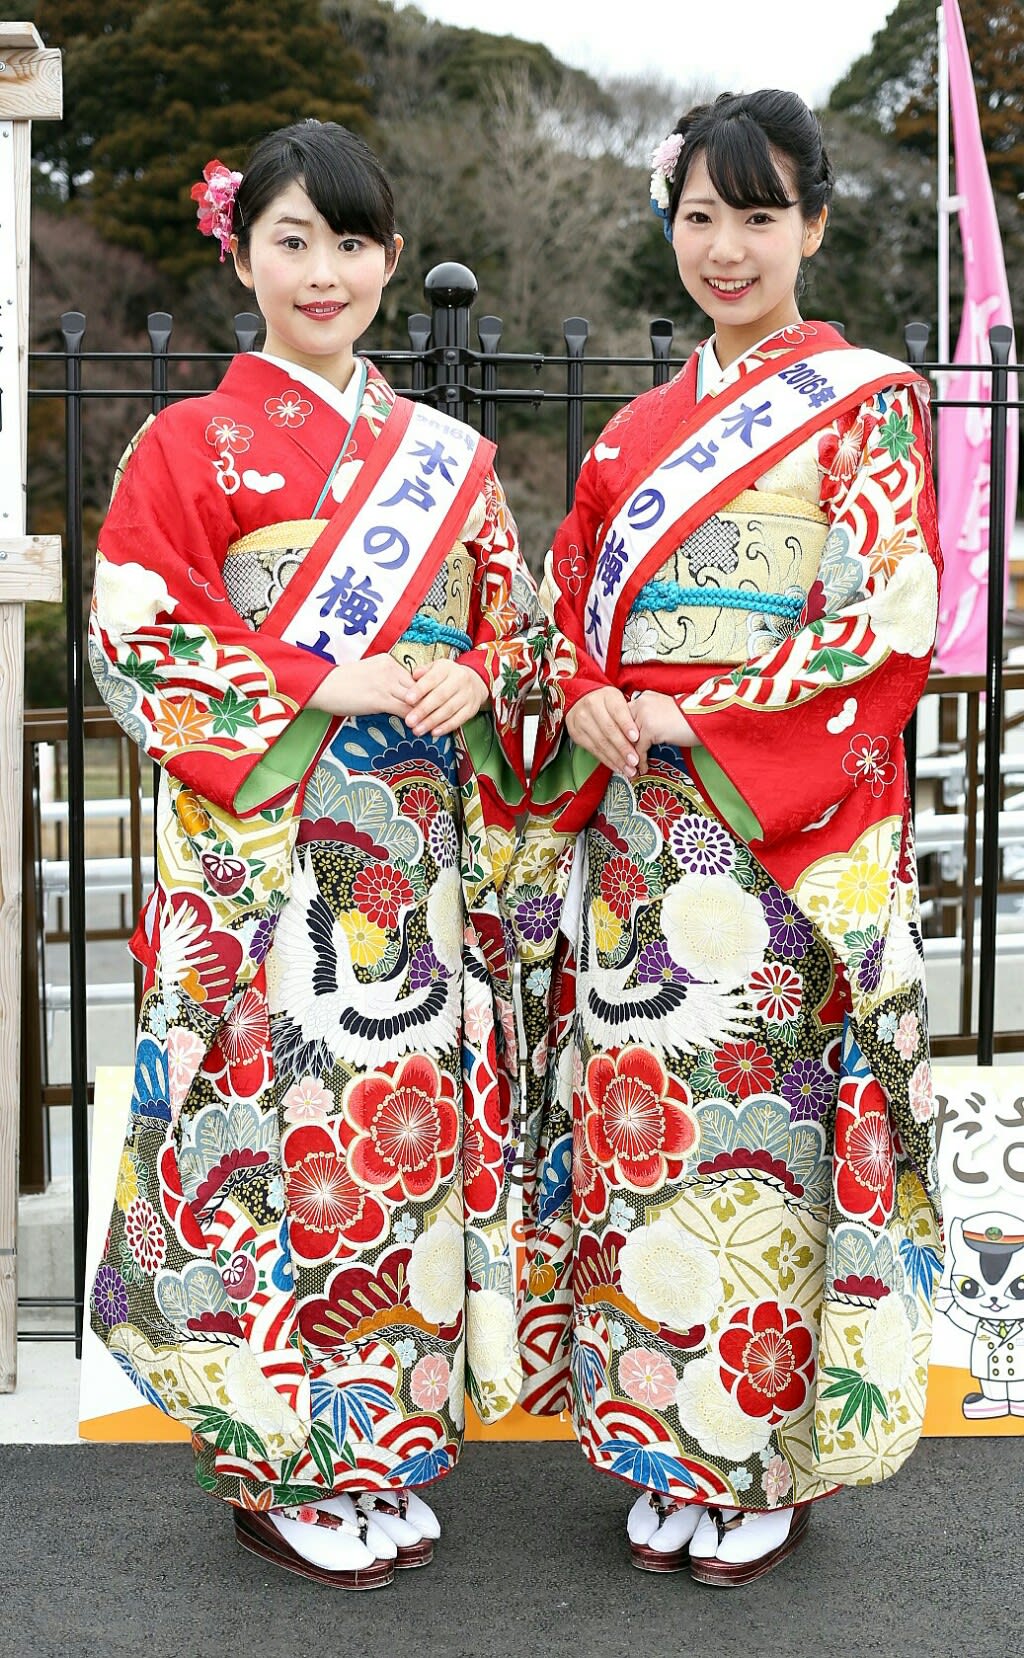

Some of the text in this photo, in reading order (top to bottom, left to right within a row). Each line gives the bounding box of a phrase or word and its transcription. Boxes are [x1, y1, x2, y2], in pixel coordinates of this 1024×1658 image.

[778, 362, 836, 408] 2016年
[585, 400, 772, 657] 水戸の梅大
